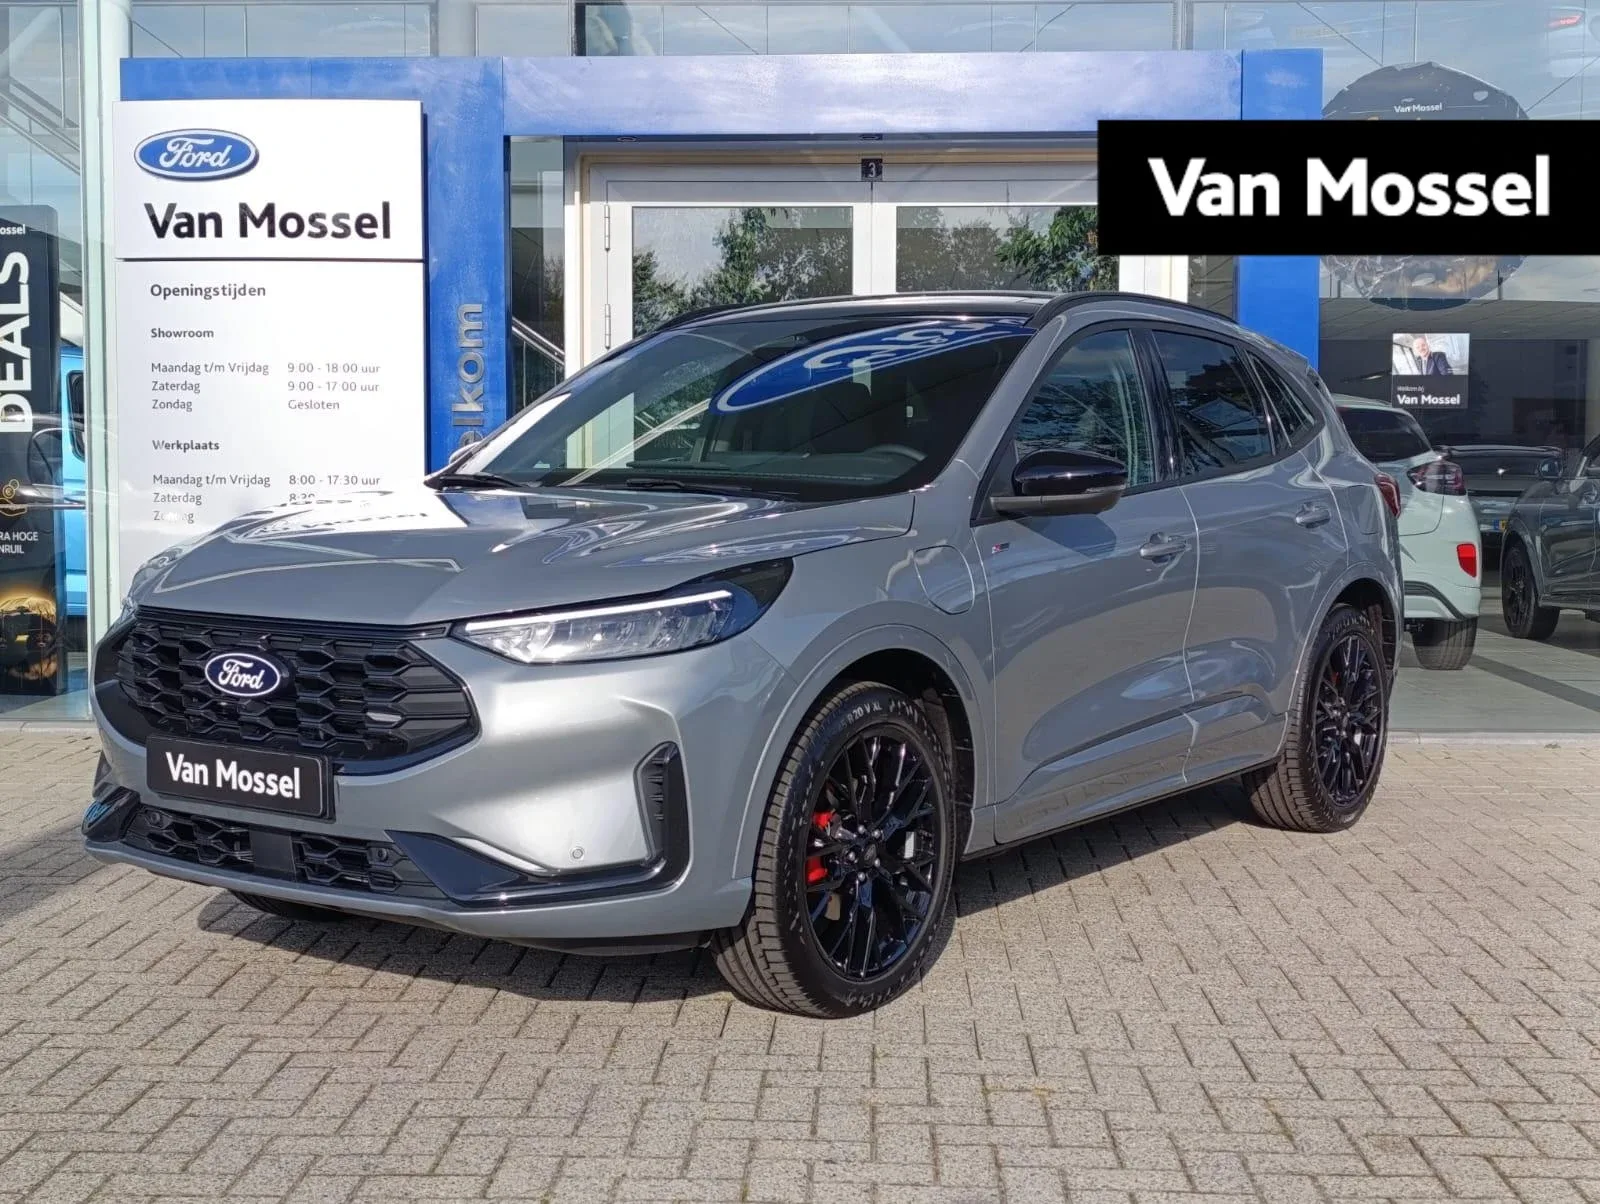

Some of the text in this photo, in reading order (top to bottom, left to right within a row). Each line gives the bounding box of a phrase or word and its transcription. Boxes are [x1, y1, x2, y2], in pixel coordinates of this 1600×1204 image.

[1394, 102, 1443, 113] Van Mossel
[159, 137, 232, 168] Ford
[868, 162, 876, 178] 3
[144, 200, 391, 239] Van Mossel
[150, 283, 266, 301] Openingstijden
[150, 327, 215, 339] Showroom
[0, 251, 33, 433] DEALS
[151, 361, 201, 375] Maandag
[204, 362, 225, 374] t/m
[229, 361, 269, 376] Vrijdag
[361, 364, 381, 373] uur
[151, 380, 201, 394] Zaterdag
[360, 383, 380, 392] uur
[151, 399, 340, 412] Zondag Gesloten
[1396, 393, 1461, 405] Van Mossel
[152, 439, 220, 451] Werkplaats
[152, 474, 203, 488] Maandag
[205, 474, 227, 486] t/m
[230, 474, 271, 488] Vrijdag
[288, 474, 316, 486] 8:00
[327, 474, 358, 486] 17:30
[361, 476, 381, 486] uur
[152, 492, 202, 505] Zaterdag
[12, 531, 39, 541] HOGE
[218, 658, 266, 690] Ford
[165, 751, 300, 799] Van Mossel
